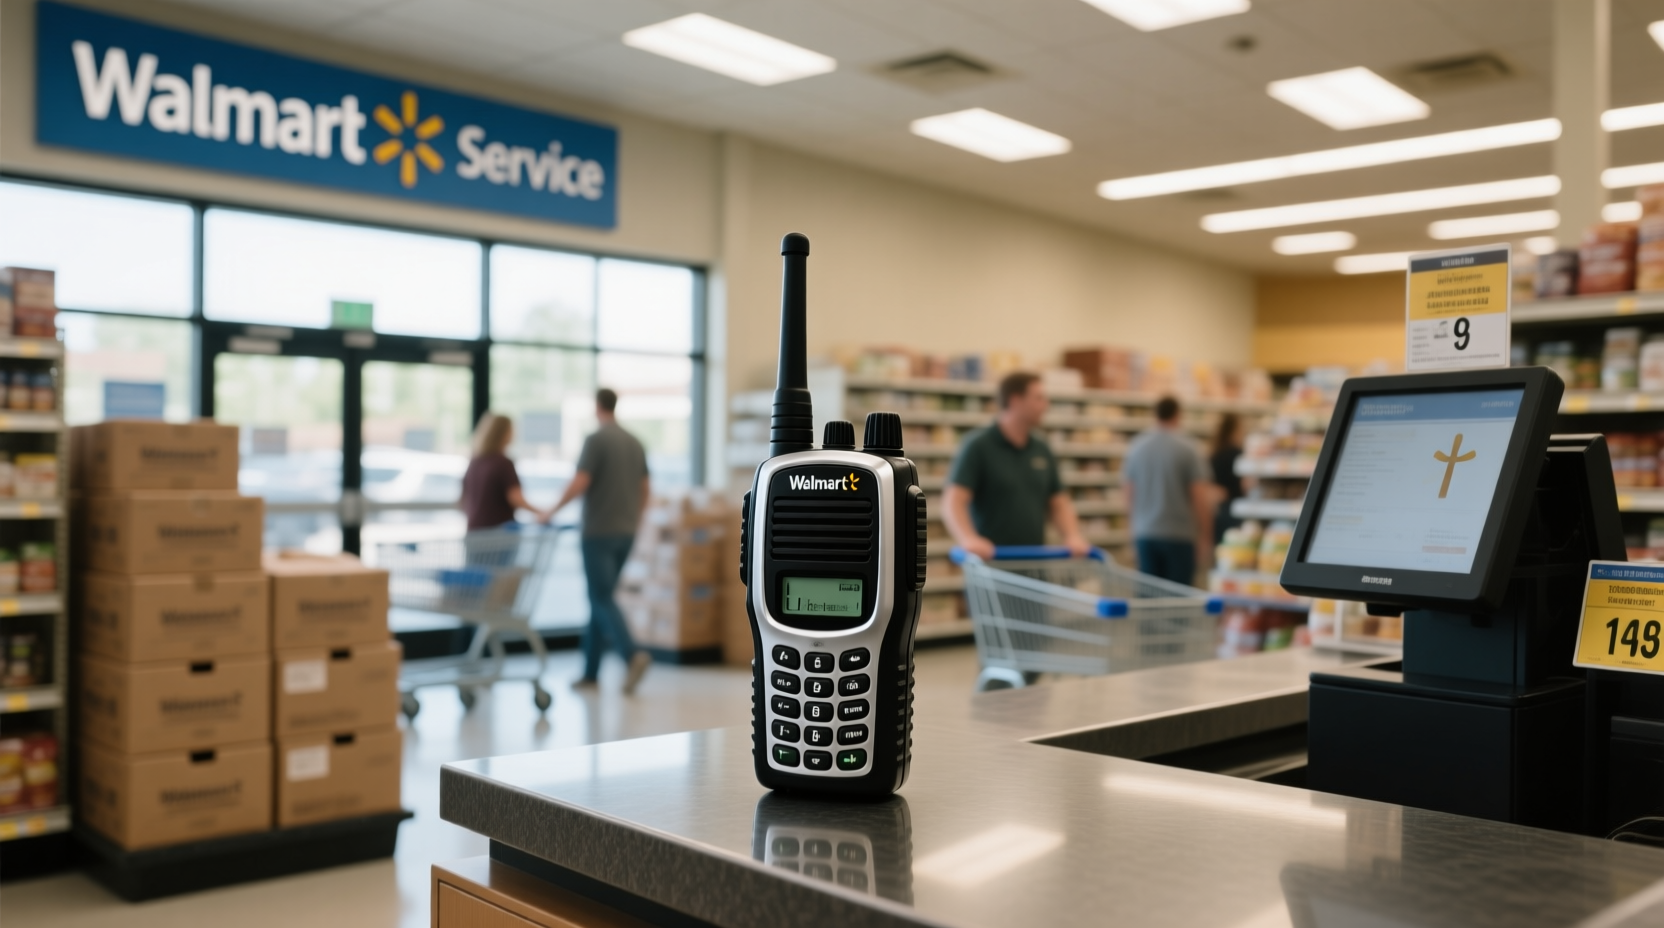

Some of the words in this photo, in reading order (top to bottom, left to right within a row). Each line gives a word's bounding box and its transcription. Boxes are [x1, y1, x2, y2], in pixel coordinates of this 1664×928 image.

[72, 40, 367, 165] Walmart
[456, 125, 605, 200] Service
[1453, 317, 1471, 351] 9
[789, 474, 849, 491] Walmart
